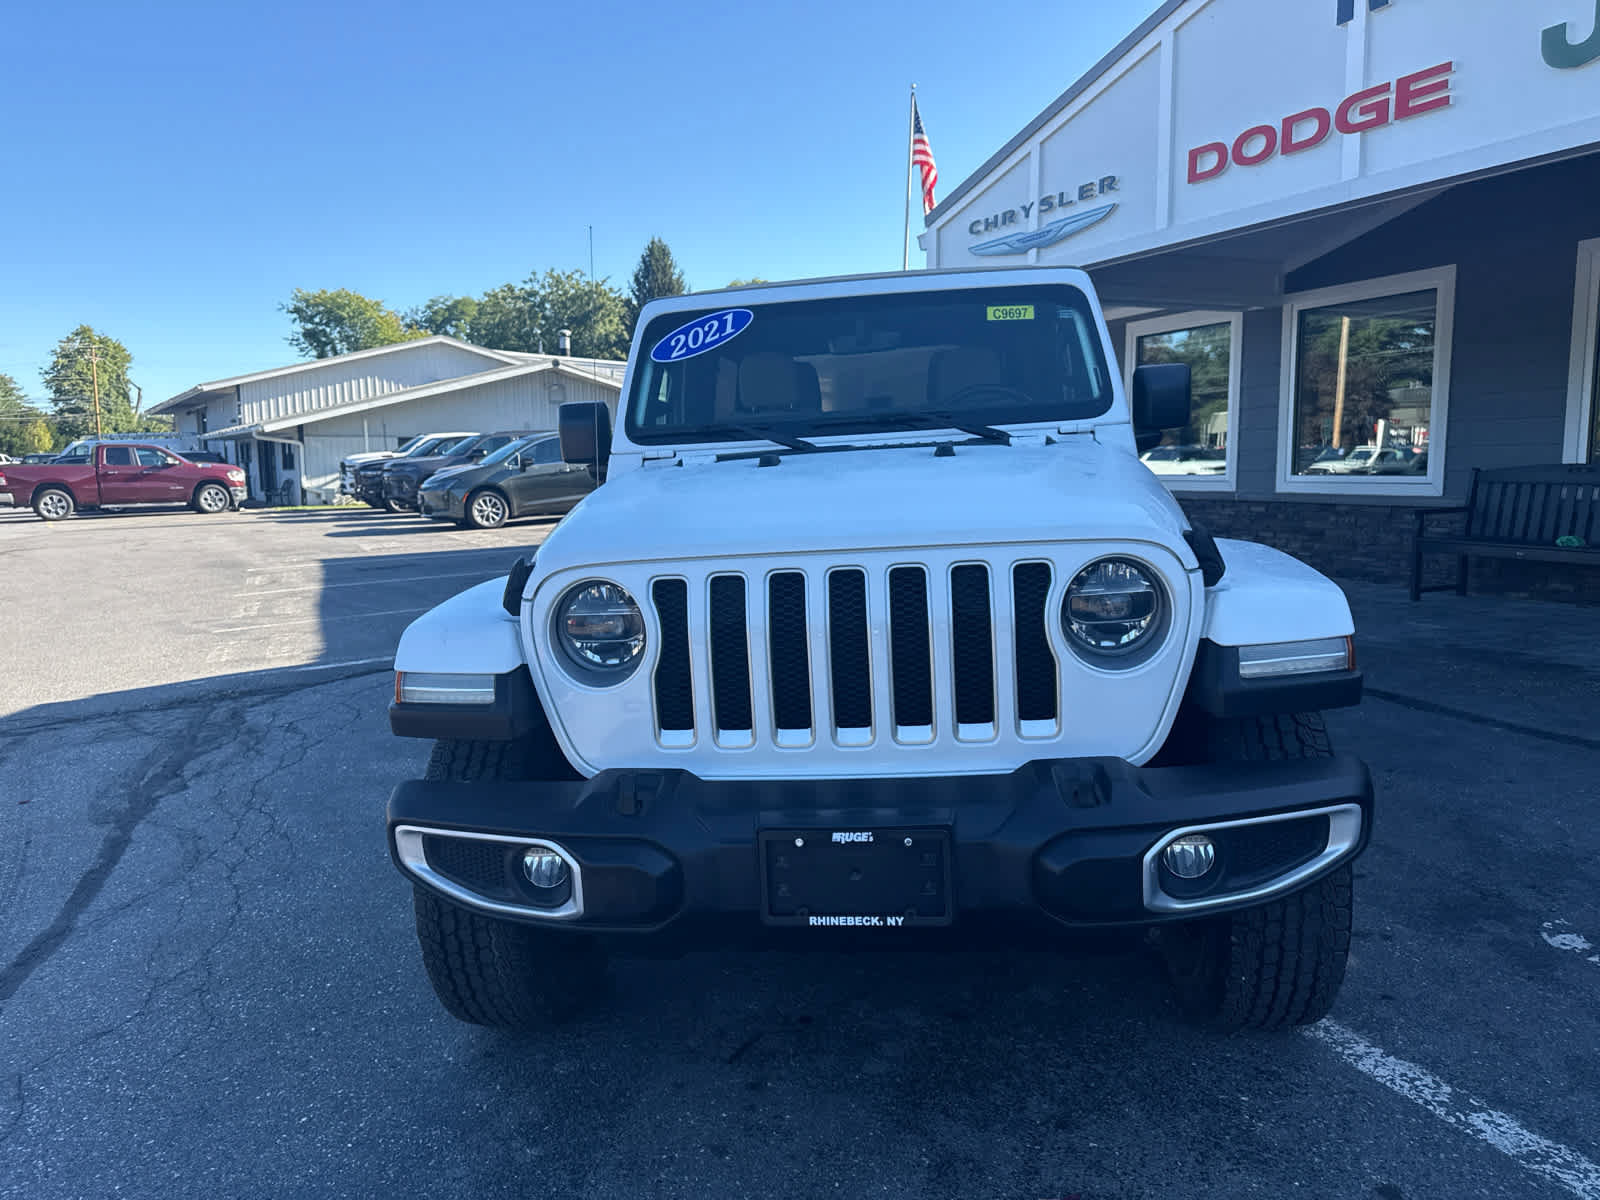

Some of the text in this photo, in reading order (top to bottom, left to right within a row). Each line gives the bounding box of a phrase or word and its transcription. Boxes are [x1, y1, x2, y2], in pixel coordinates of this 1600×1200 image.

[1187, 60, 1456, 185] DODGE
[968, 175, 1120, 235] CHRYSLER
[670, 312, 735, 359] 2021
[993, 307, 1028, 320] C9697
[809, 916, 904, 926] RHINEBECK, NY
